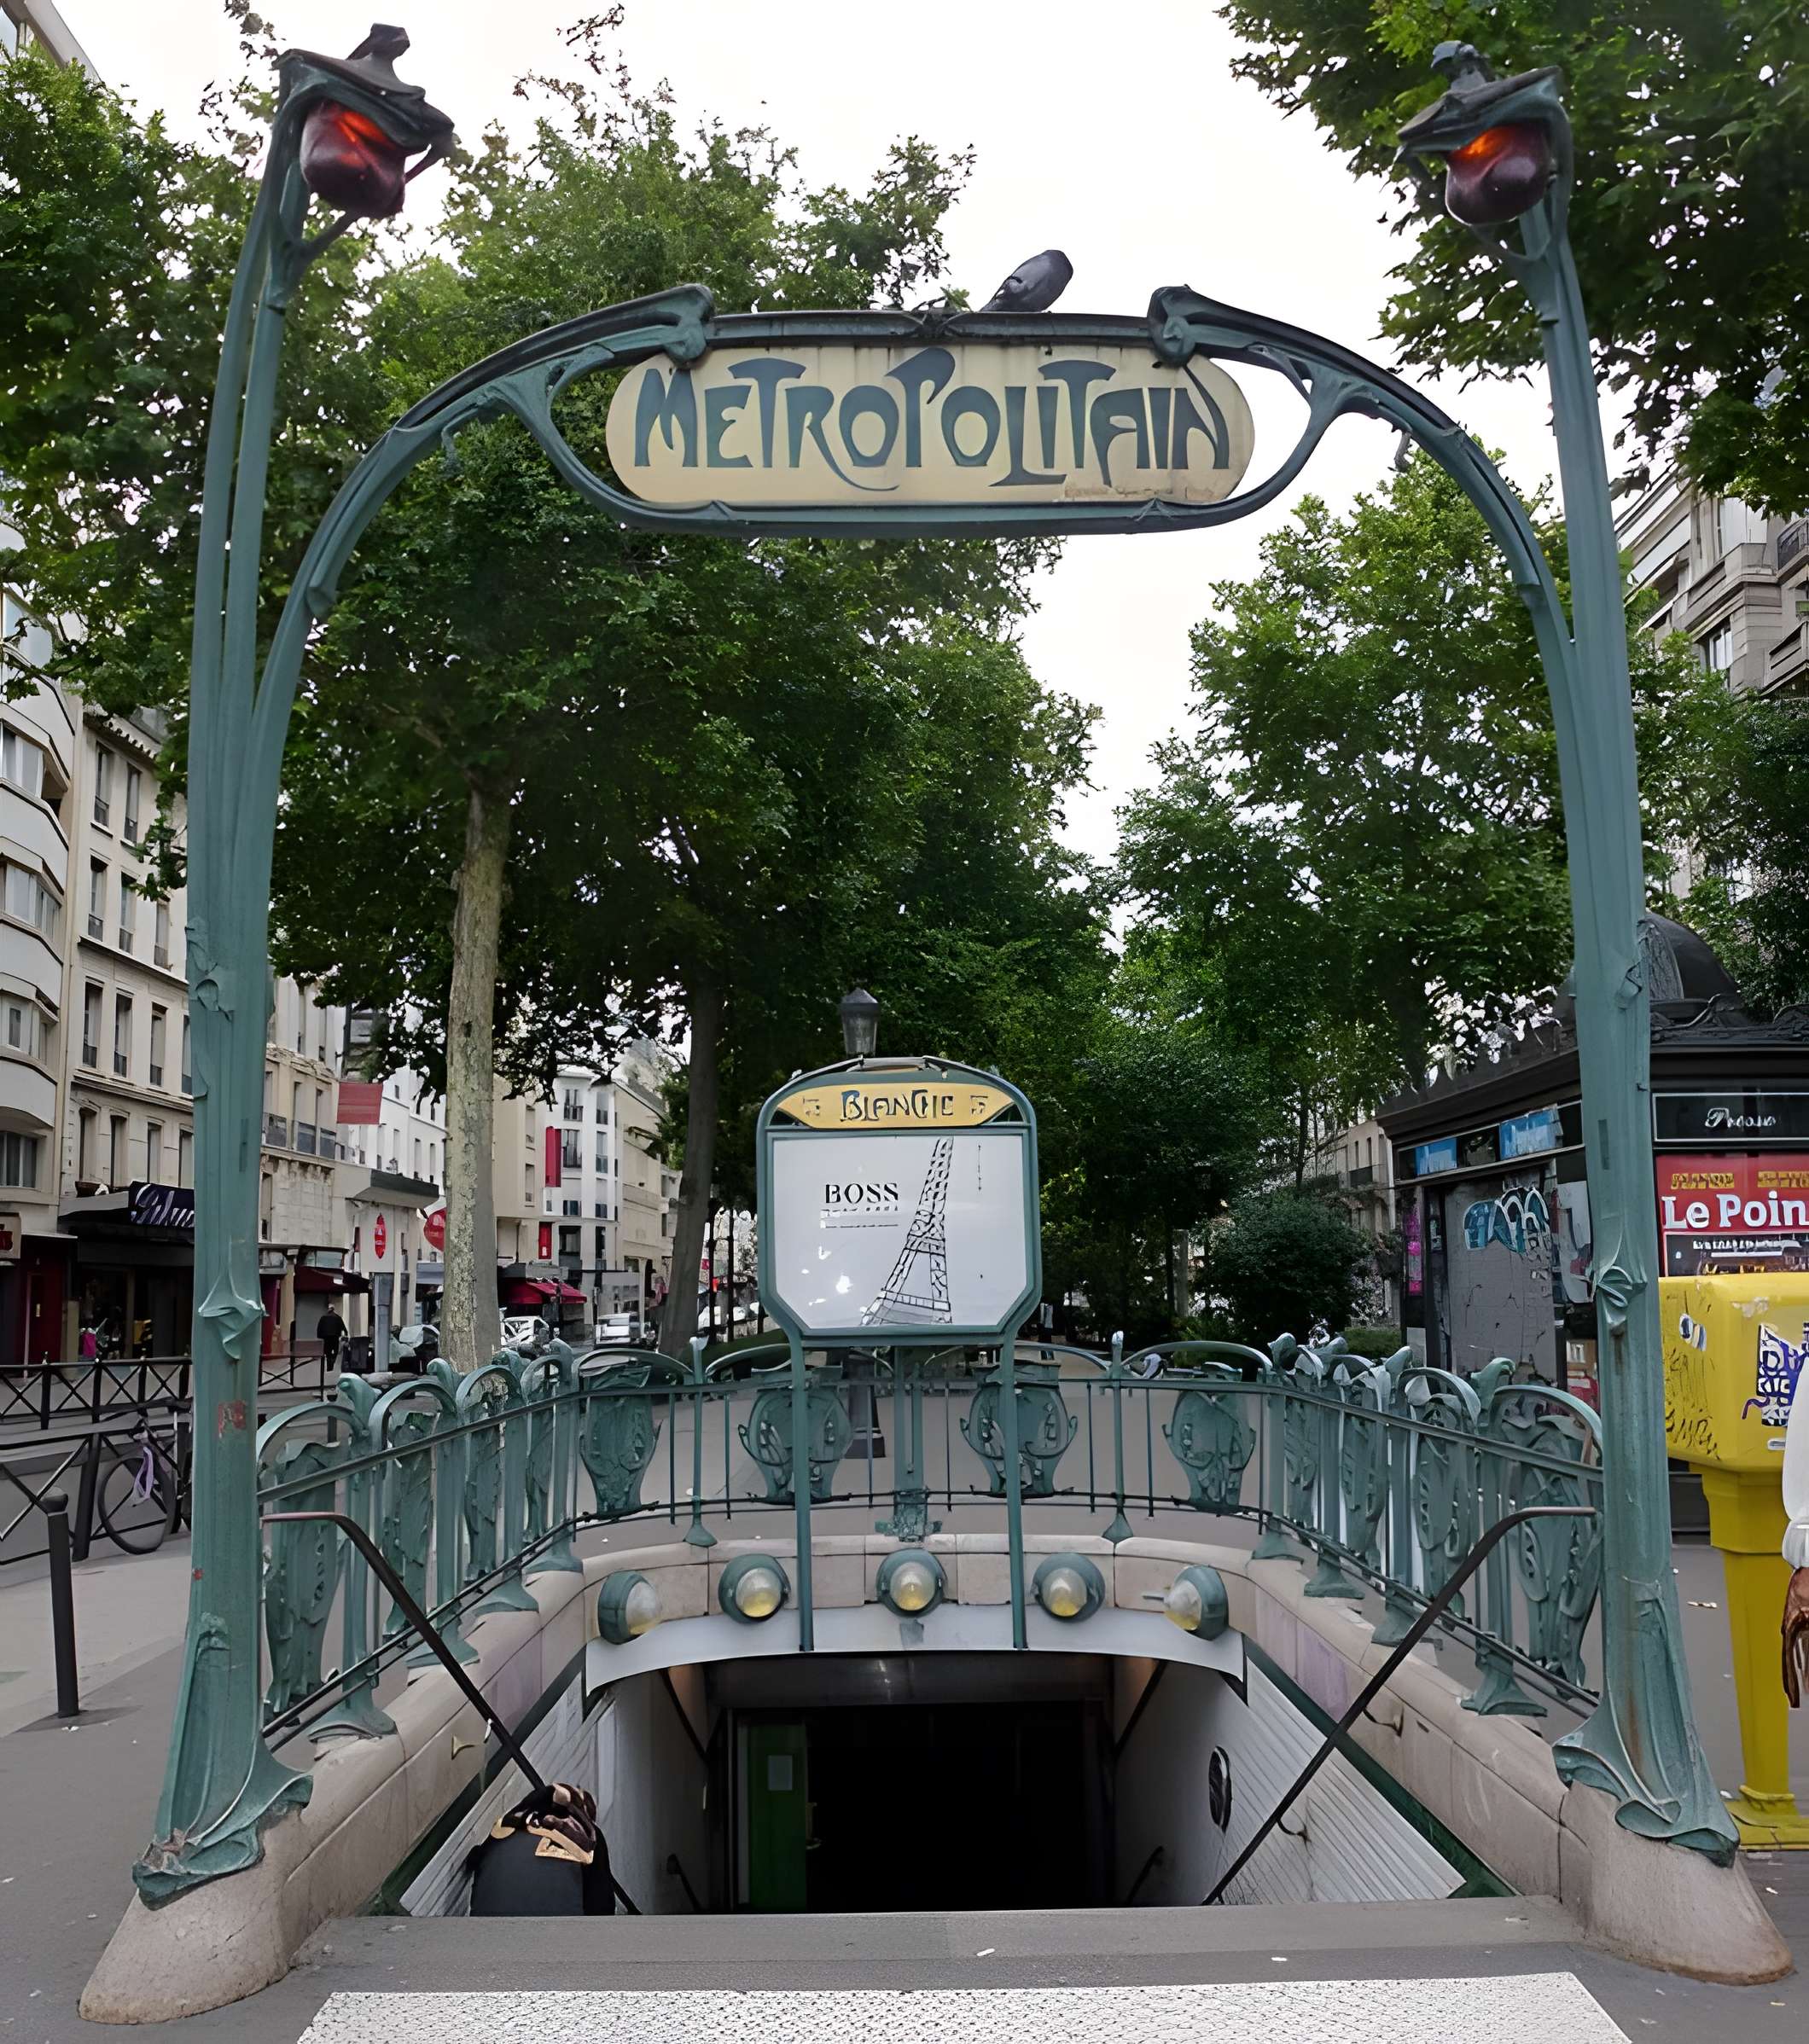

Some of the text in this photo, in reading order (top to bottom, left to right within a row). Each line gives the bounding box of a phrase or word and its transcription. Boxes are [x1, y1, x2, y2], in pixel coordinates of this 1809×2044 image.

[634, 346, 1230, 491] METROPOLITAIN
[825, 1182, 899, 1204] BOSS
[1661, 1195, 1710, 1228] Le
